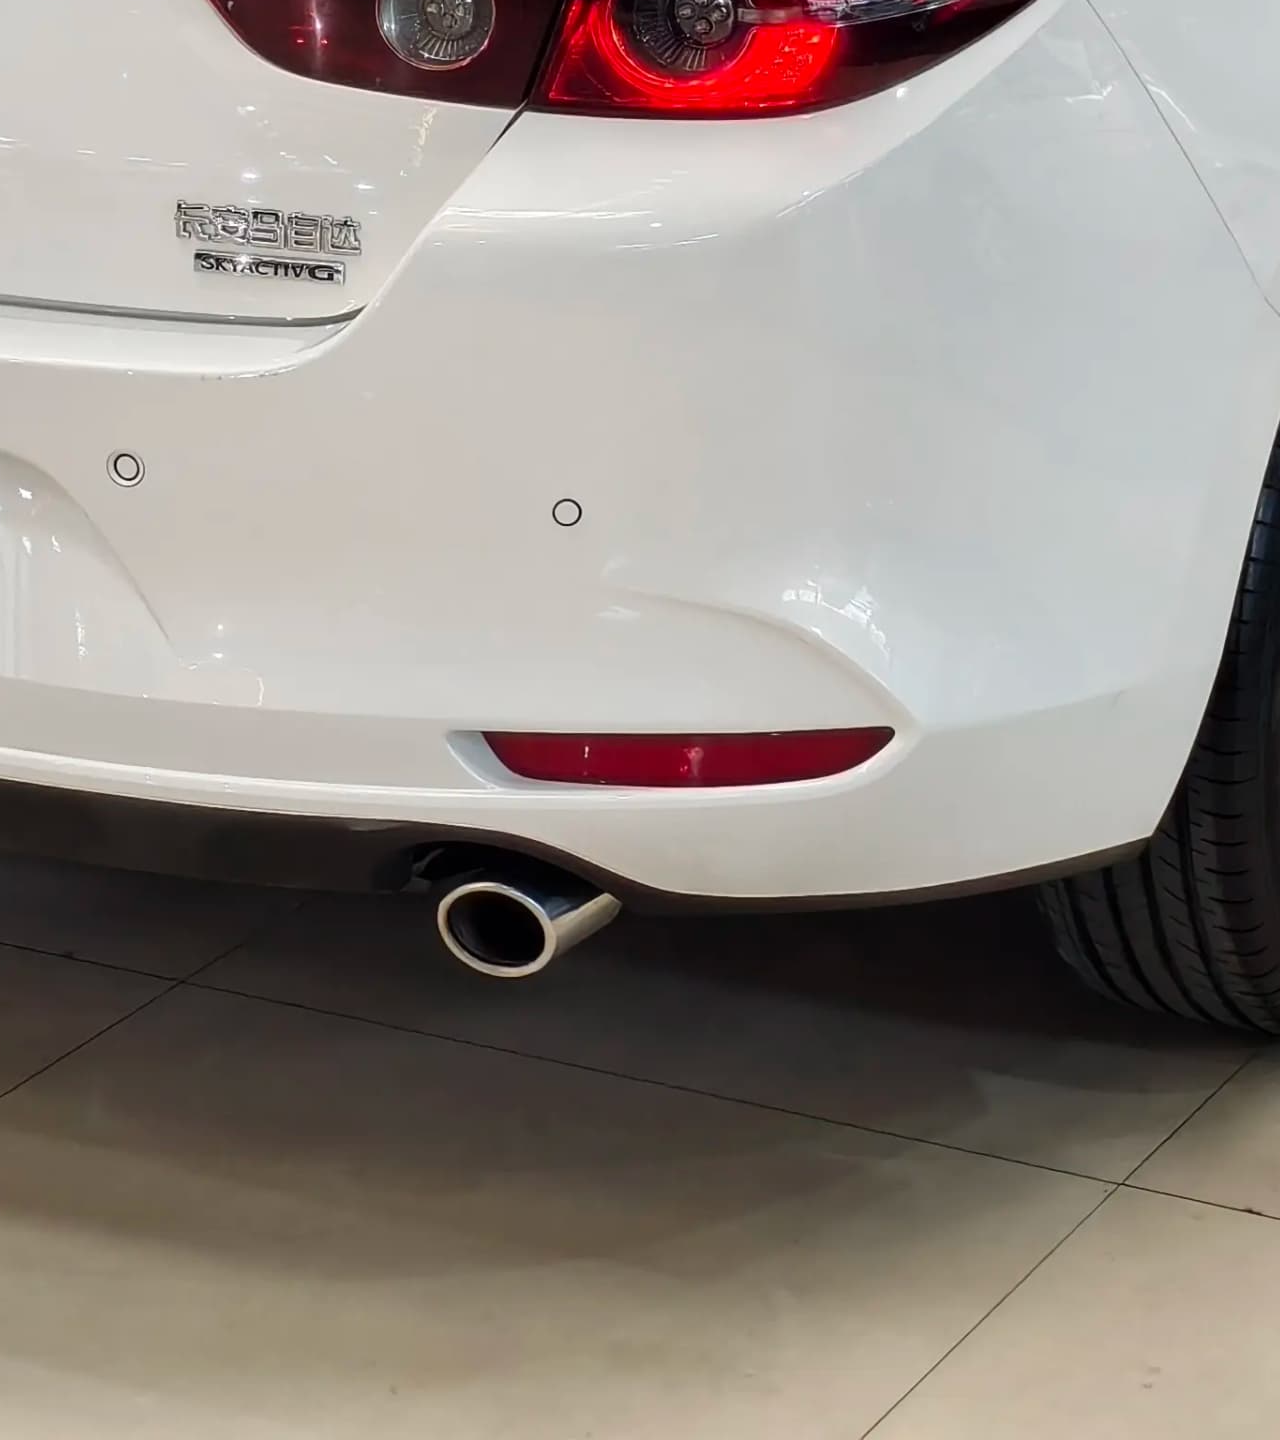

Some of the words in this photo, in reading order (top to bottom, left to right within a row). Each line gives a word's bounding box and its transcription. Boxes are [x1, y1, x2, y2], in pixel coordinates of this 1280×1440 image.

[174, 199, 362, 256] 长安马自达
